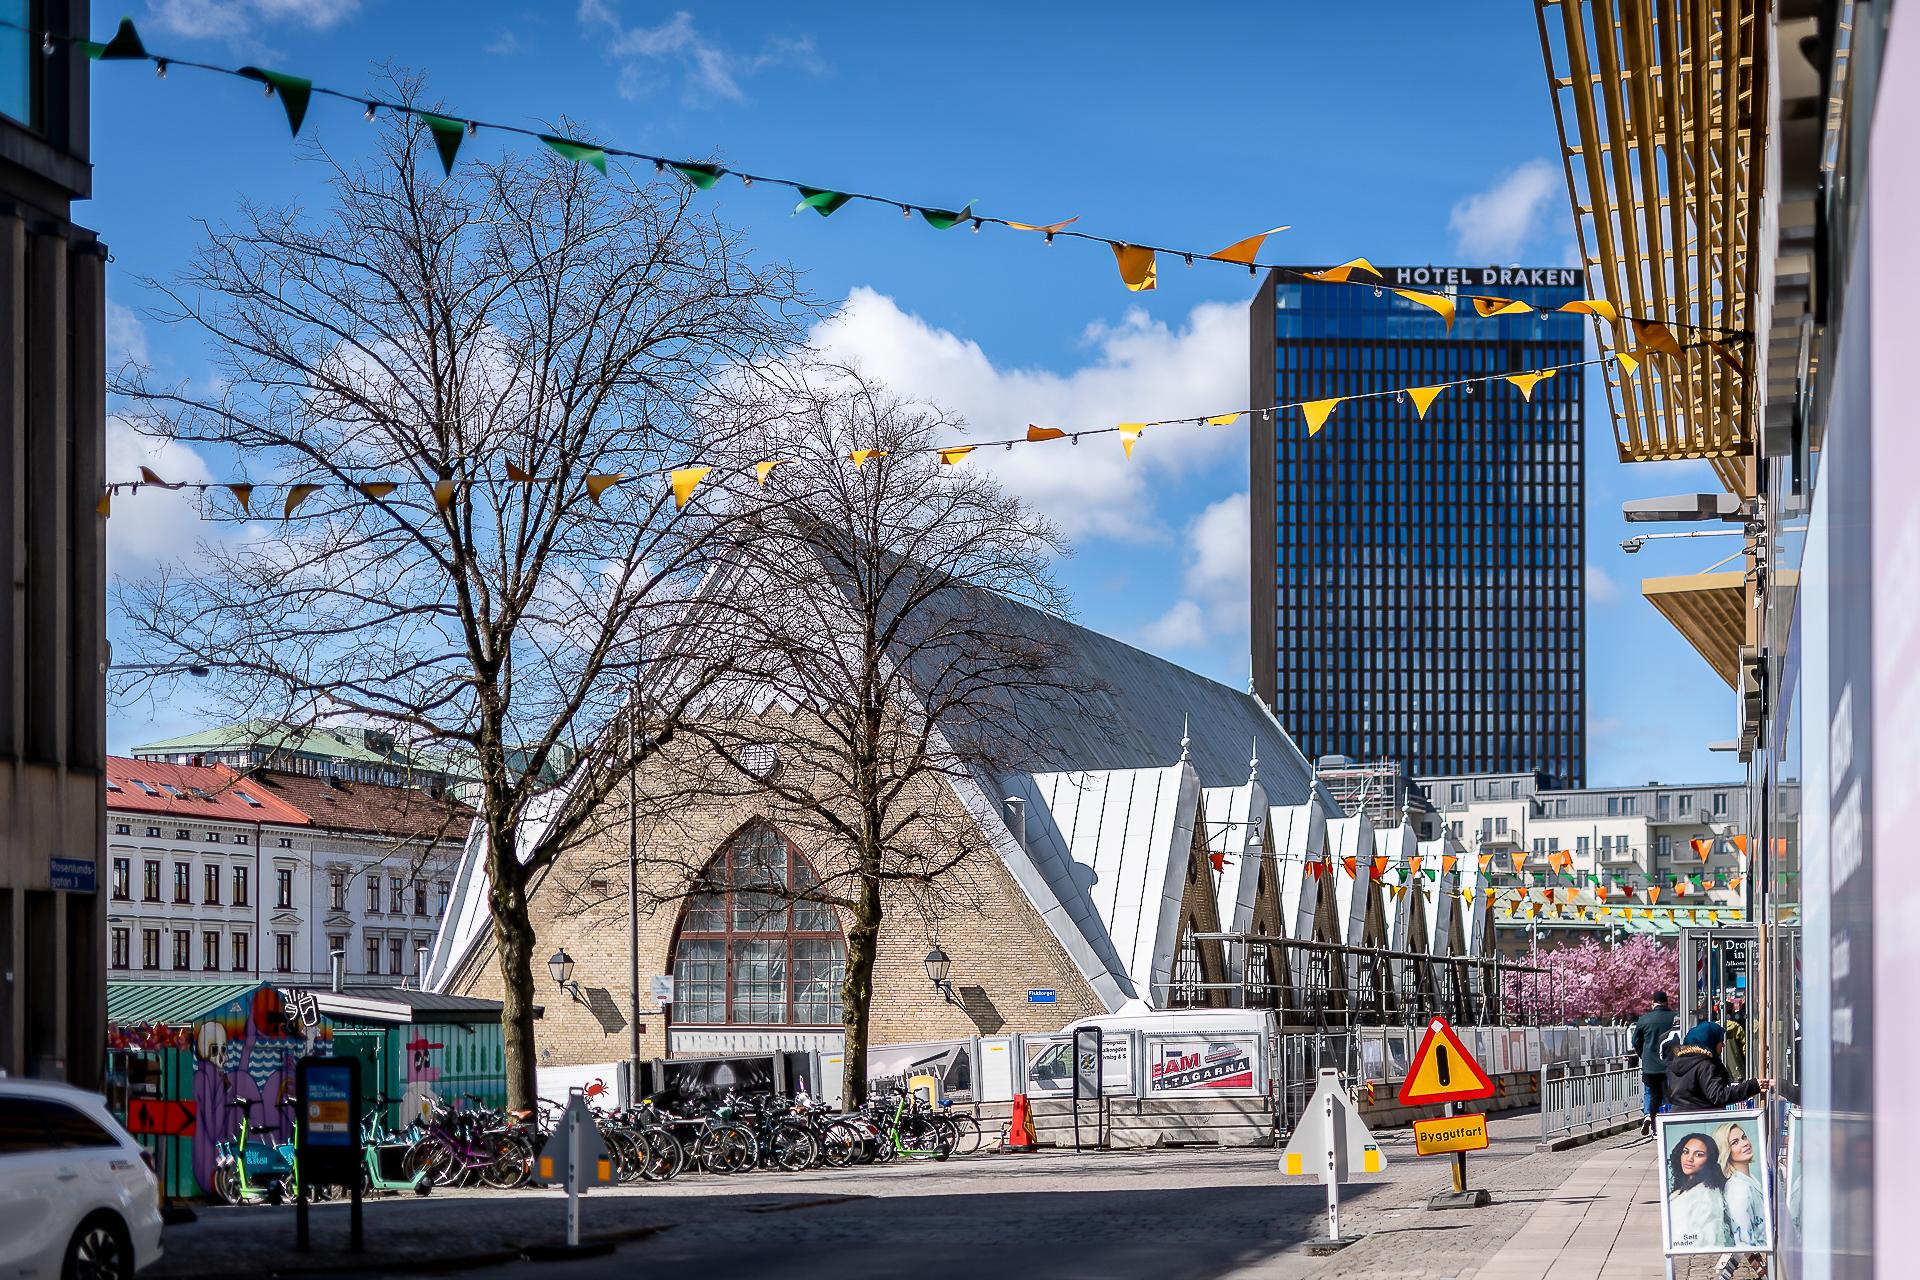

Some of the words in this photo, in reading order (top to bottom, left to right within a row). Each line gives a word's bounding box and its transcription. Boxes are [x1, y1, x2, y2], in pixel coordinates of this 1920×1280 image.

[1397, 268, 1472, 285] HOTEL
[1483, 268, 1575, 286] DRAKEN
[1725, 940, 1746, 950] Dro
[1733, 949, 1745, 959] in
[1420, 1127, 1482, 1142] Byggutfart
